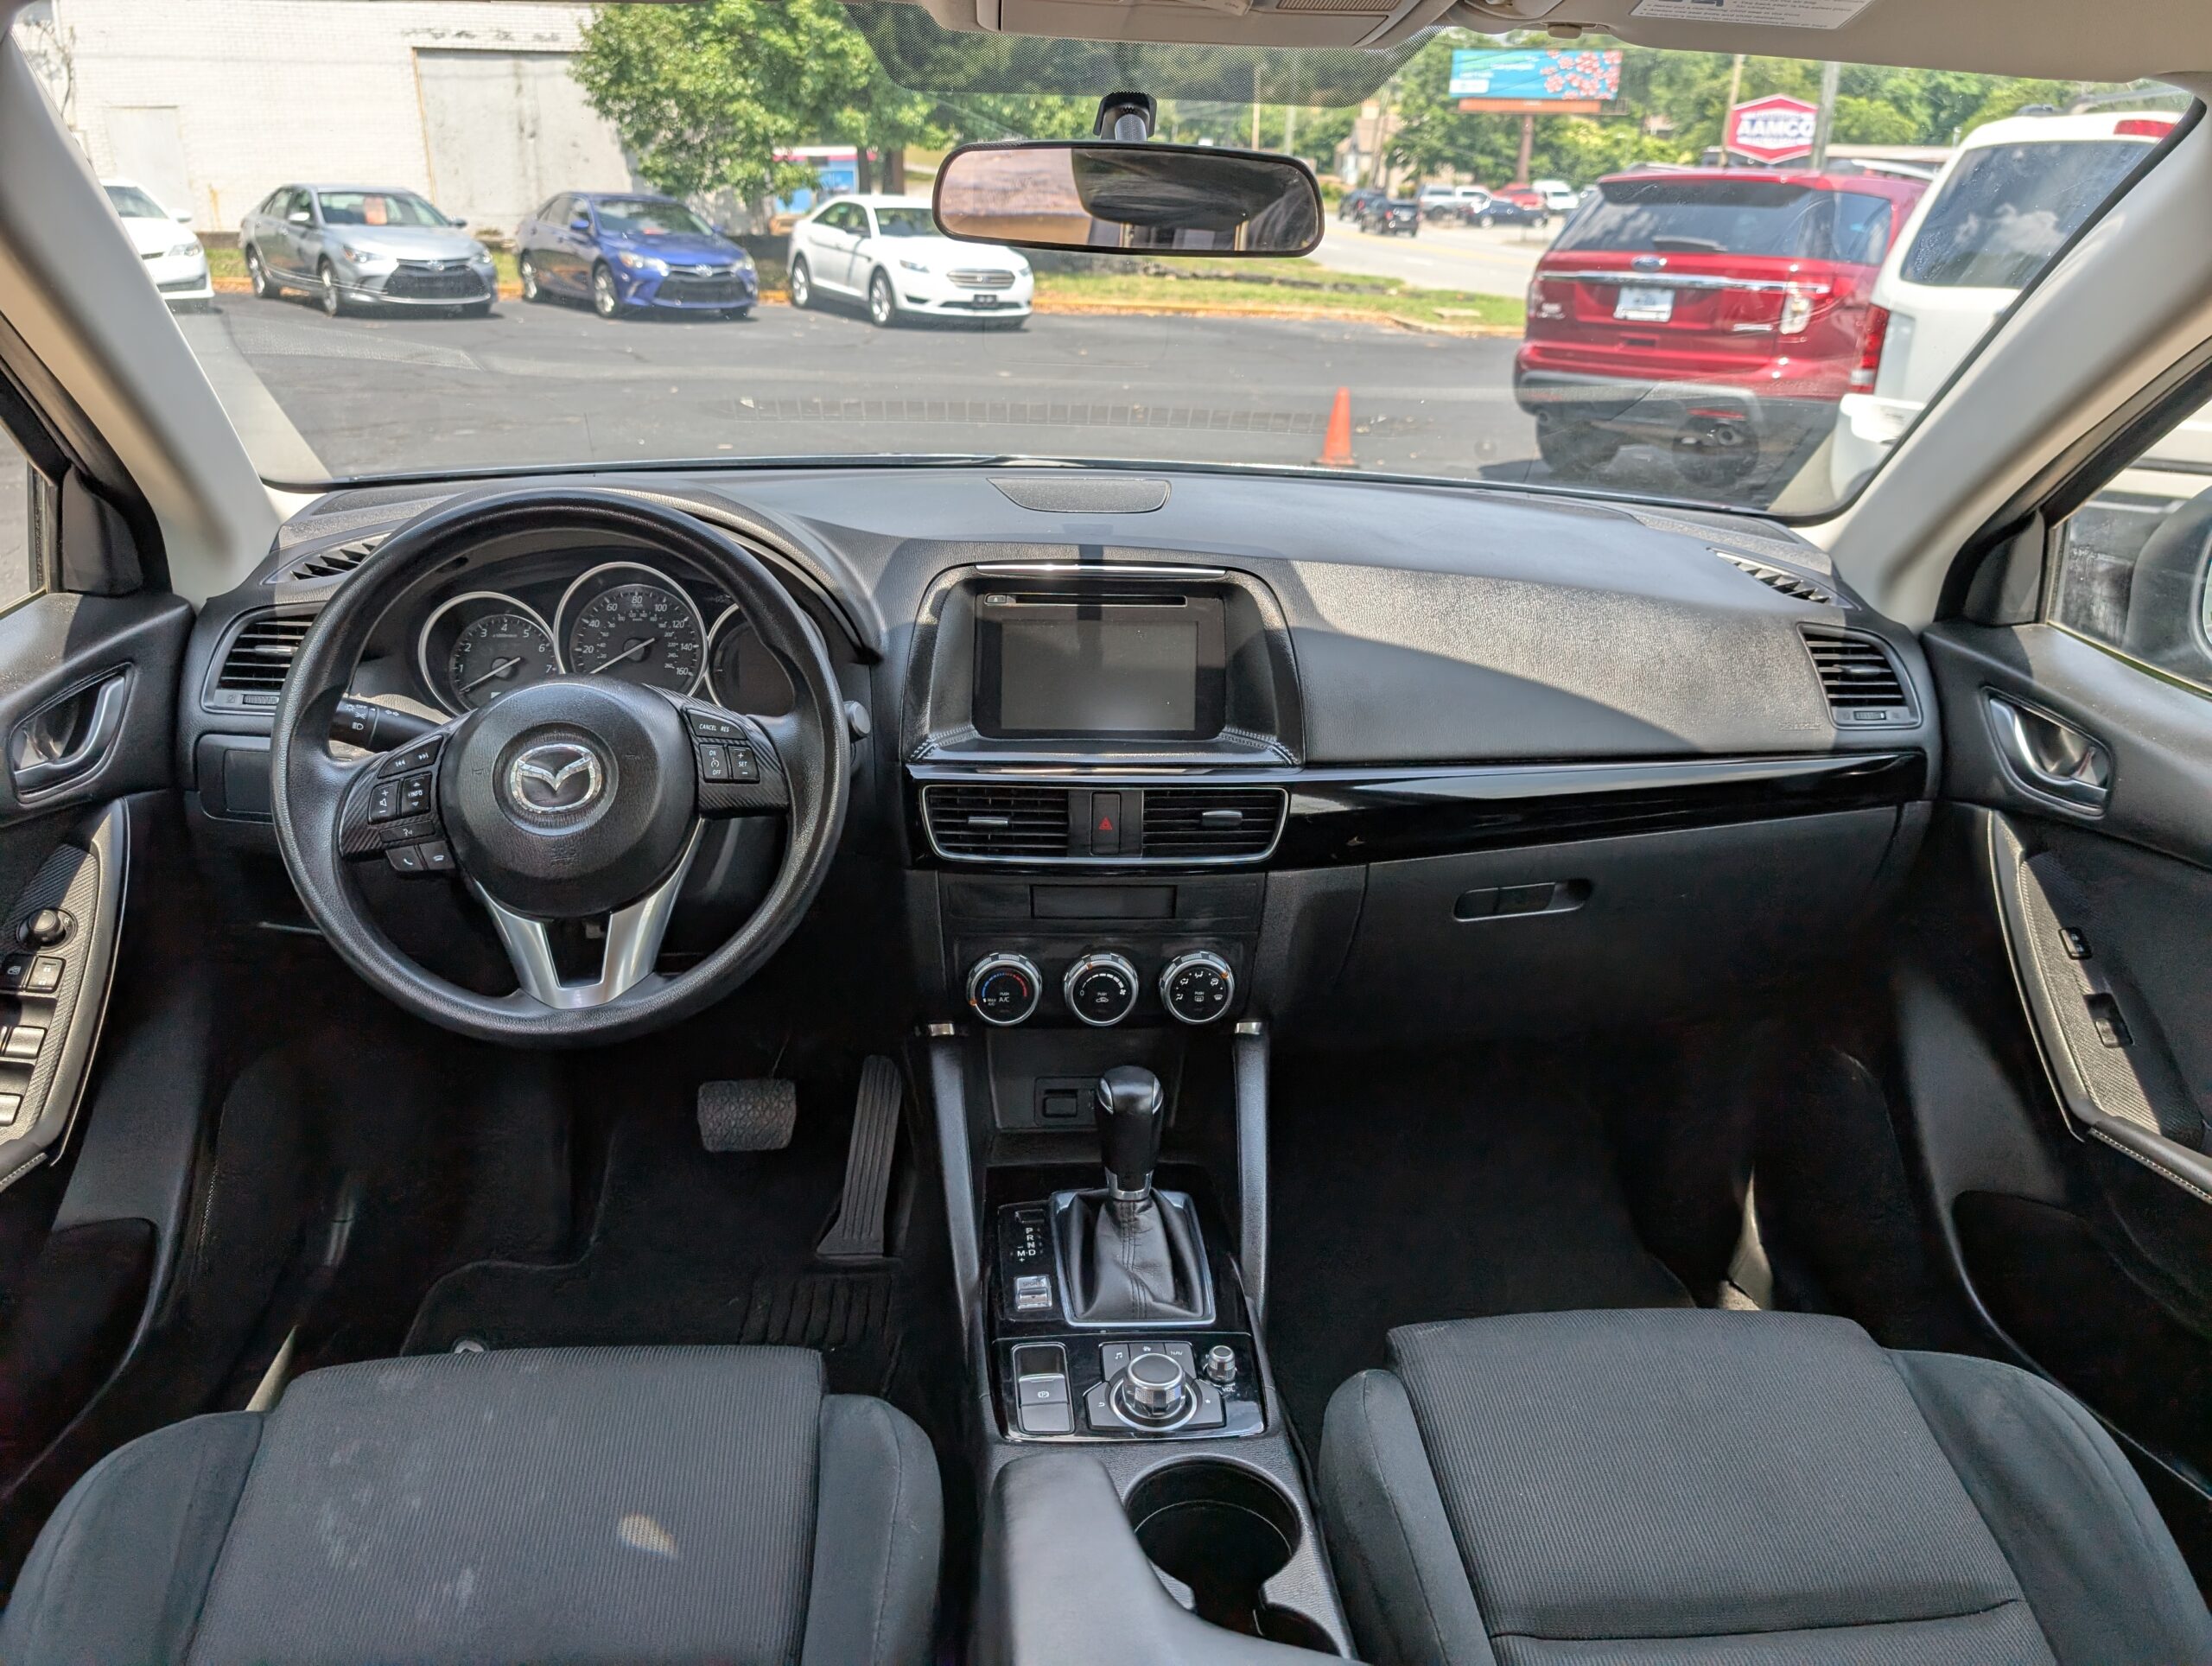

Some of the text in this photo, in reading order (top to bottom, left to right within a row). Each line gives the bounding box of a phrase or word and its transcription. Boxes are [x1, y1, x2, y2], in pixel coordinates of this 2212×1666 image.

[1736, 119, 1816, 137] AAMCO
[480, 629, 487, 638] 3
[465, 643, 471, 652] 2
[538, 644, 545, 652] 6
[545, 664, 552, 673] 7
